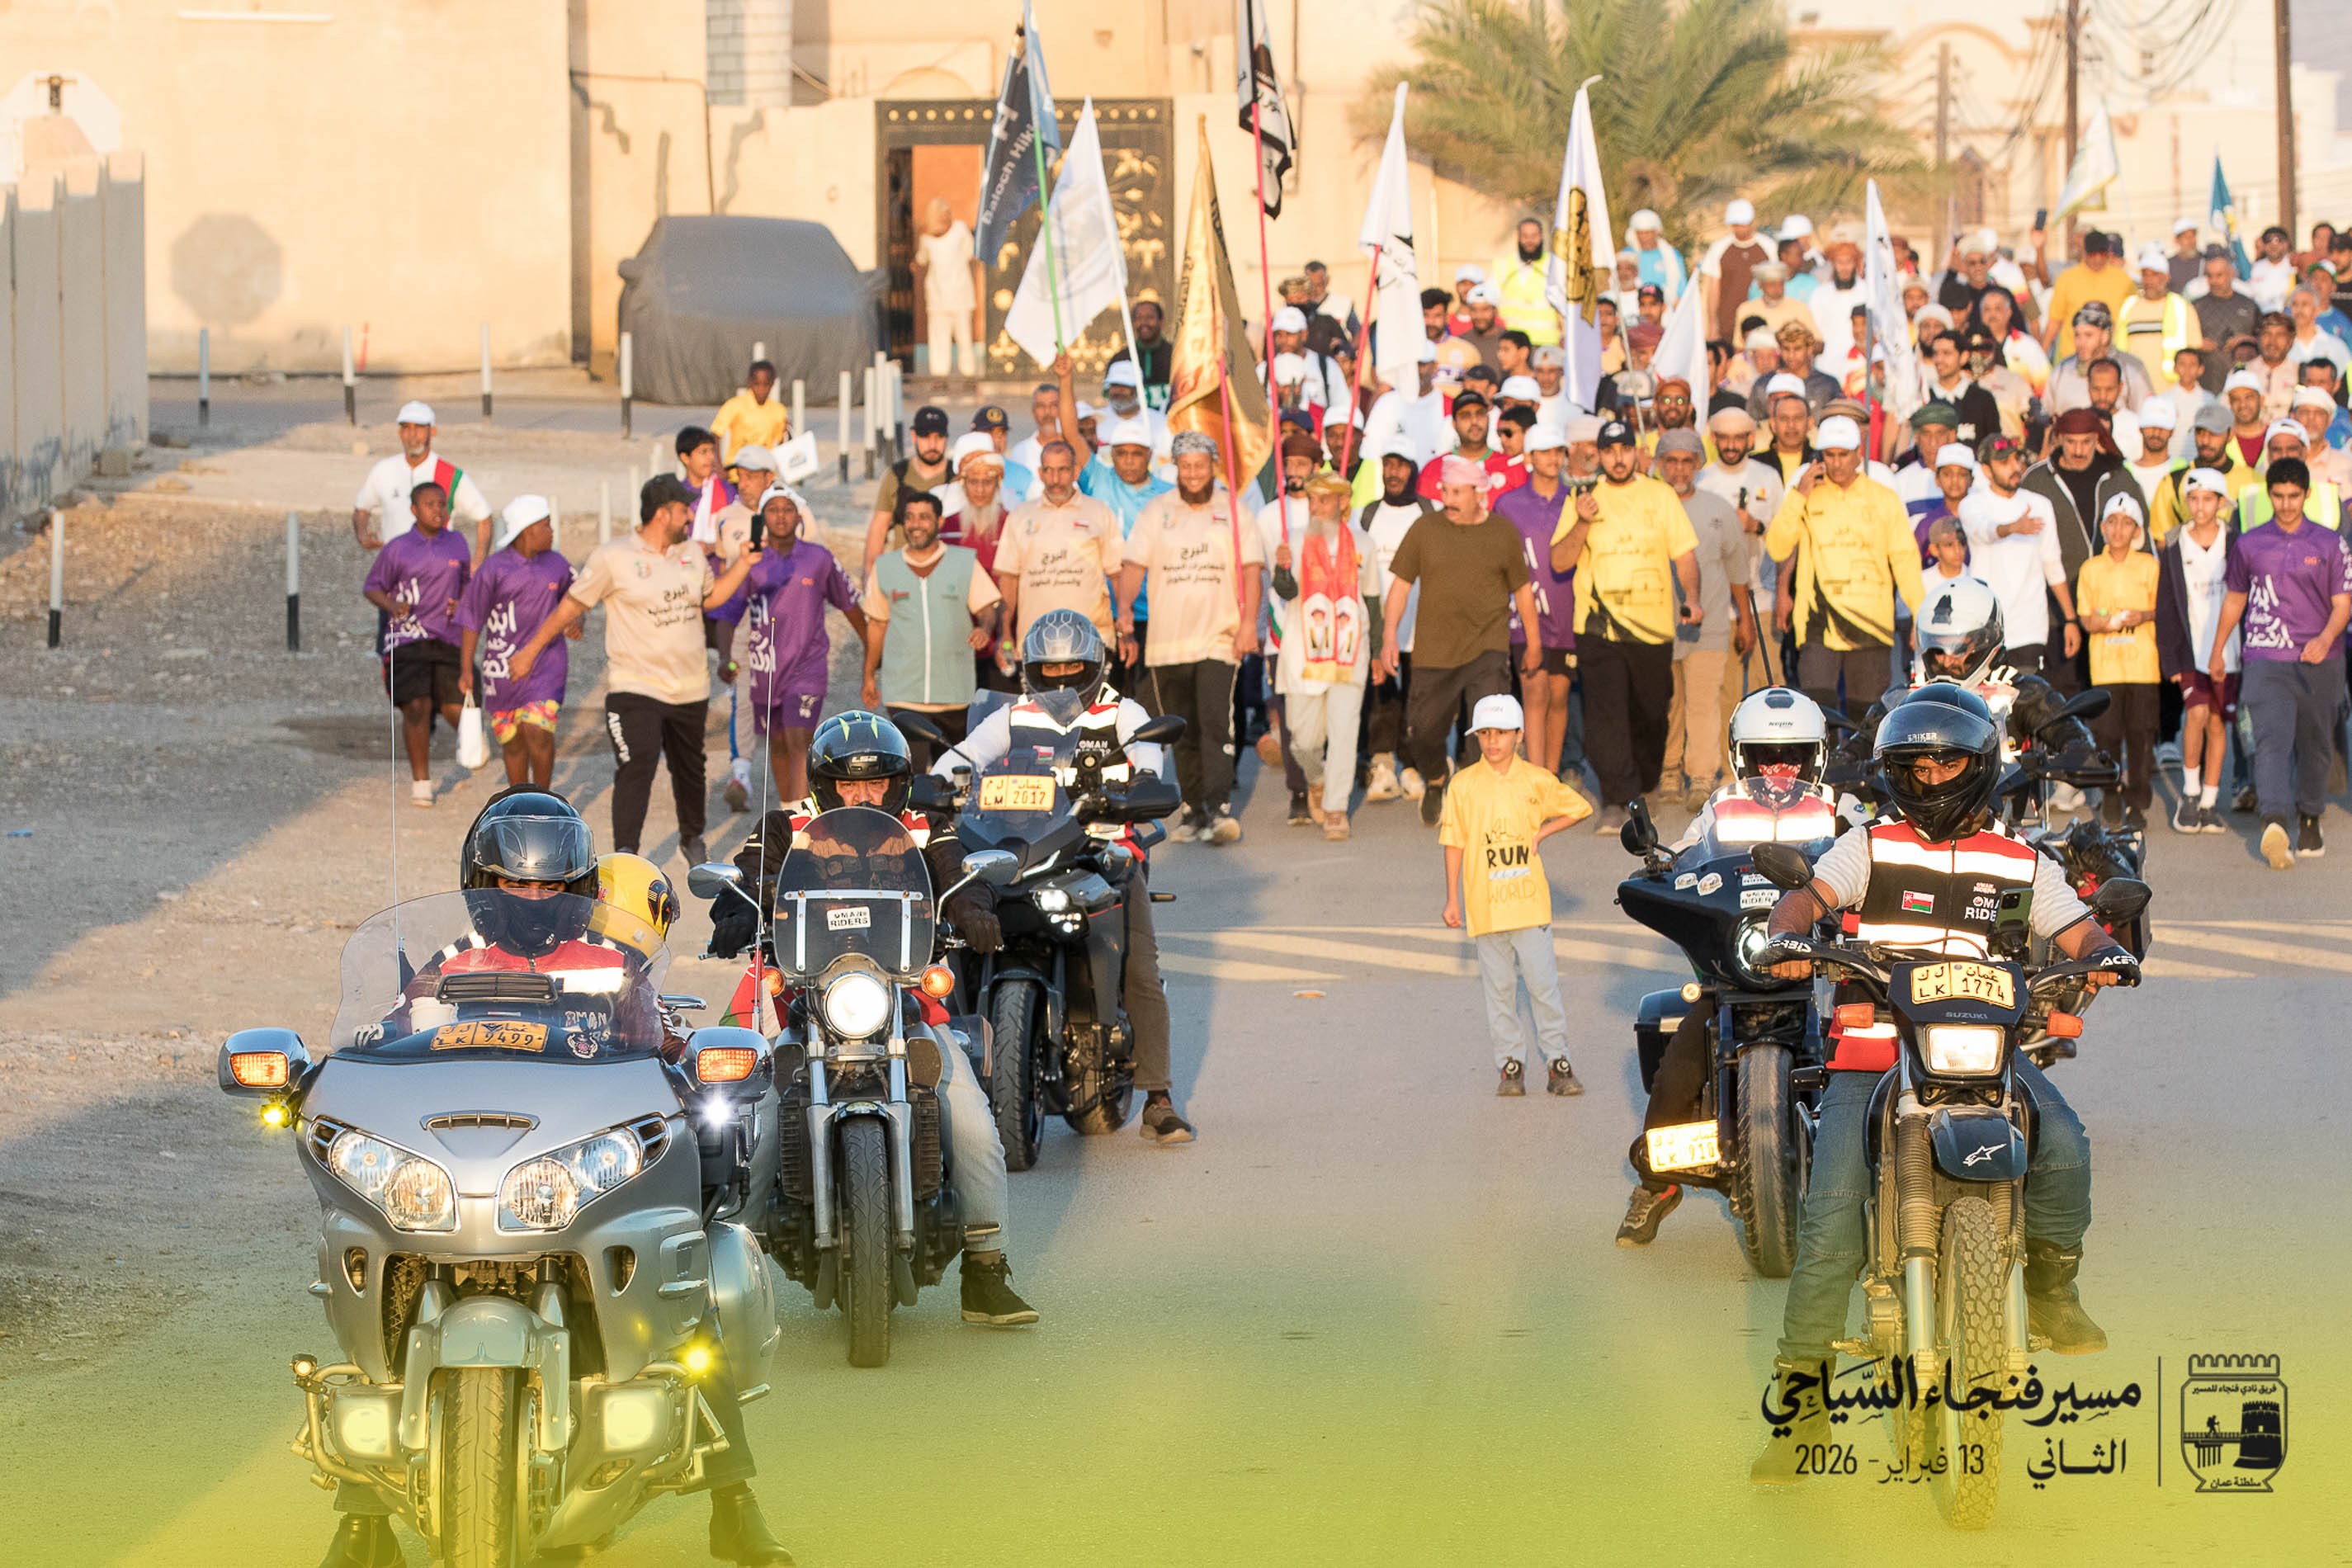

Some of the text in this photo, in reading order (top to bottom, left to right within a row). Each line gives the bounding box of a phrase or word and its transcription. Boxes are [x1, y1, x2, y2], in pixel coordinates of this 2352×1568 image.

[1079, 740, 1108, 749] OMAN
[1013, 791, 1046, 805] 2017
[1486, 845, 1529, 868] RUN
[1972, 895, 2000, 909] OM
[834, 910, 862, 919] OMAN
[1964, 906, 1997, 922] RIDE
[830, 917, 868, 927] RIDERS
[1962, 977, 2005, 1001] 1774
[484, 1032, 535, 1046] 9499
[1688, 1141, 1716, 1162] 910
